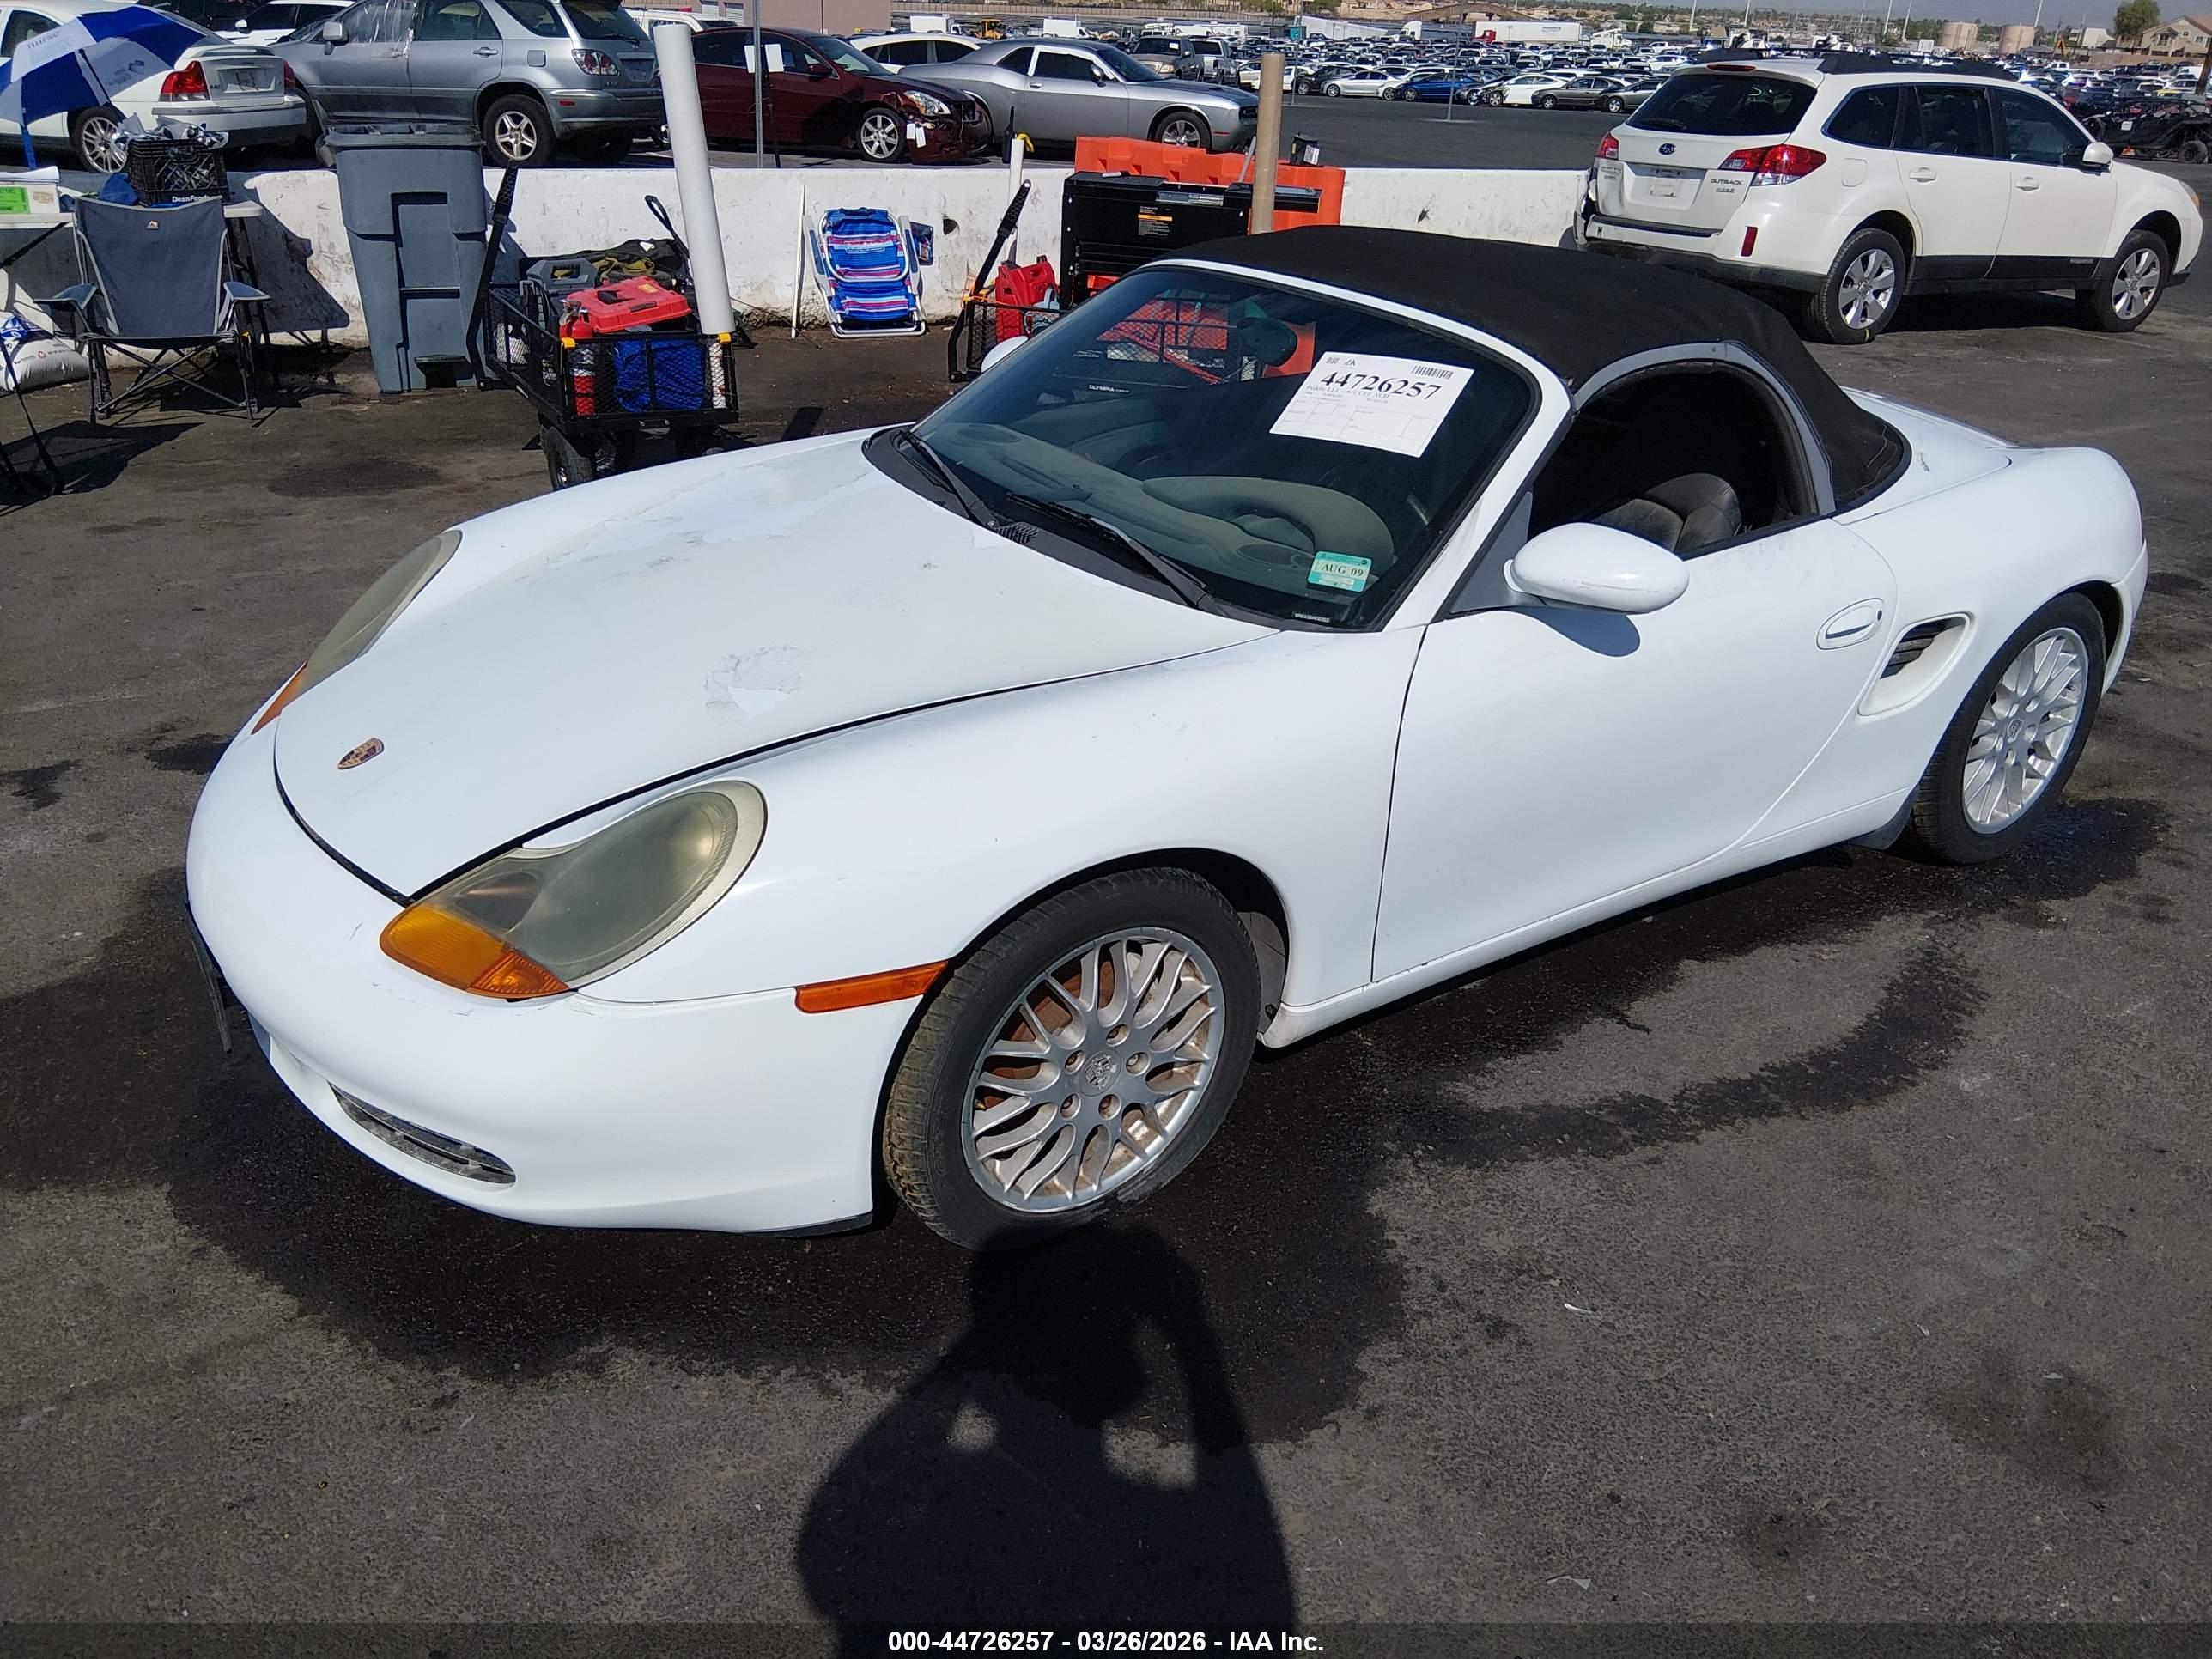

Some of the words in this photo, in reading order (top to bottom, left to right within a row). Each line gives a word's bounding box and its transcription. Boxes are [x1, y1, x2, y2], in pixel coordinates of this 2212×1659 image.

[1321, 372, 1443, 399] 44726257
[1321, 563, 1347, 574] AUG
[1351, 568, 1364, 577] 09
